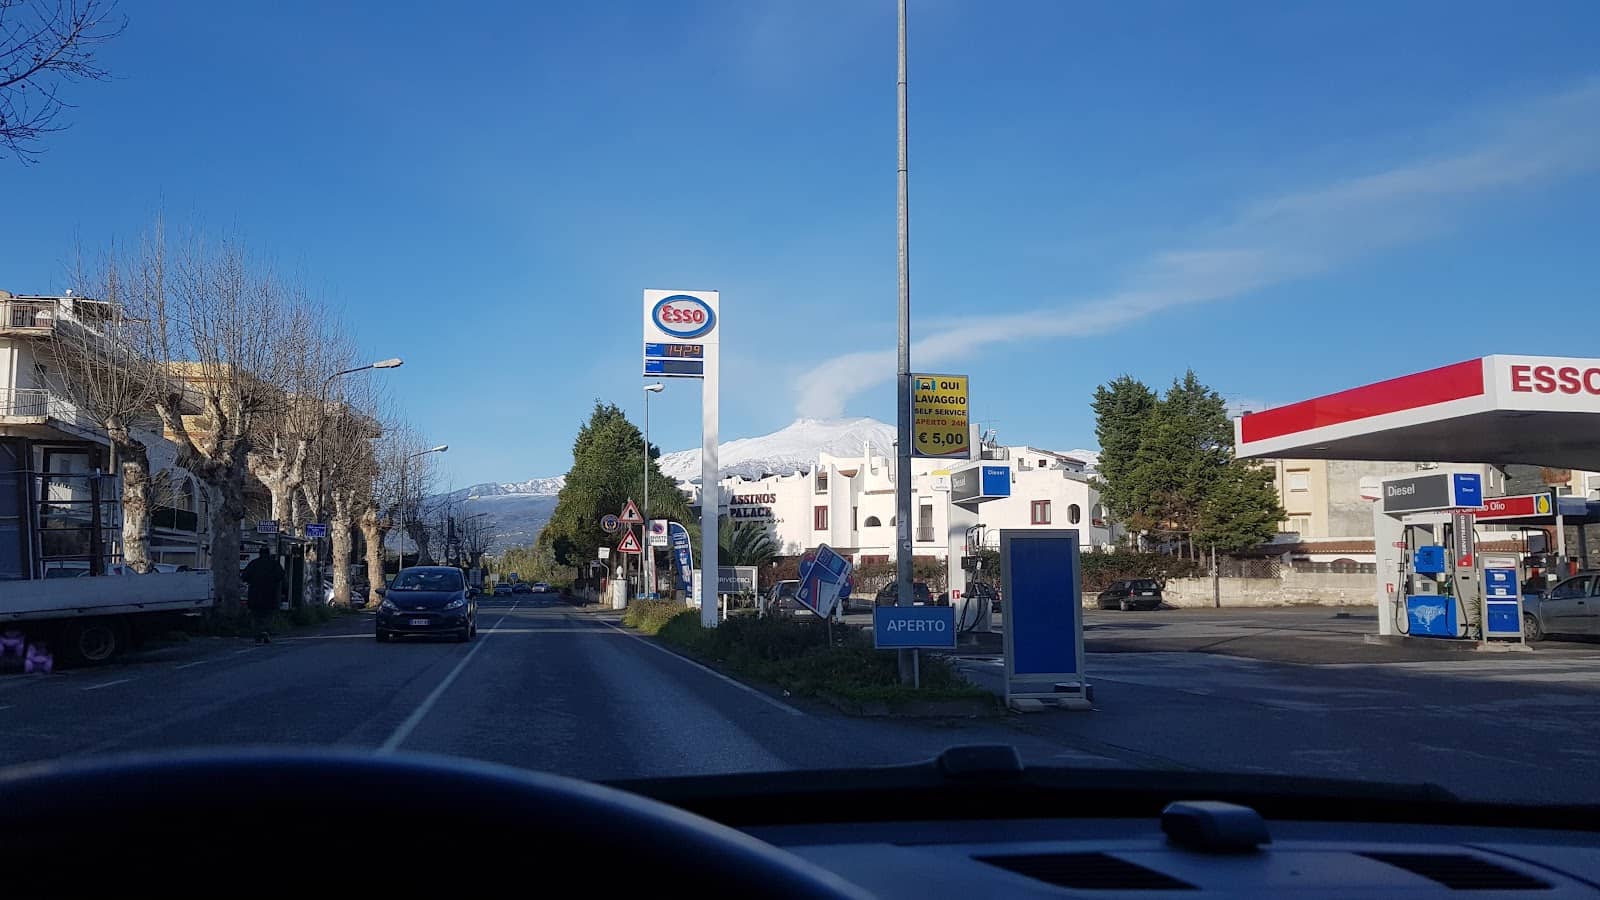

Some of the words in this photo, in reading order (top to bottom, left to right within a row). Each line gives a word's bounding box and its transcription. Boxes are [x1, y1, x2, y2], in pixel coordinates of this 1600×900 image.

[940, 381, 959, 390] QUI
[915, 395, 966, 405] LAVAGGIO
[915, 418, 947, 426] APERTO
[951, 419, 966, 427] 24H
[918, 432, 928, 444] €
[932, 432, 963, 446] 5,00
[1388, 483, 1415, 497] Diesel
[730, 493, 776, 505] ASSINOS
[1490, 501, 1506, 511] Olio
[729, 507, 772, 518] PALACE
[887, 619, 946, 632] APERTO
